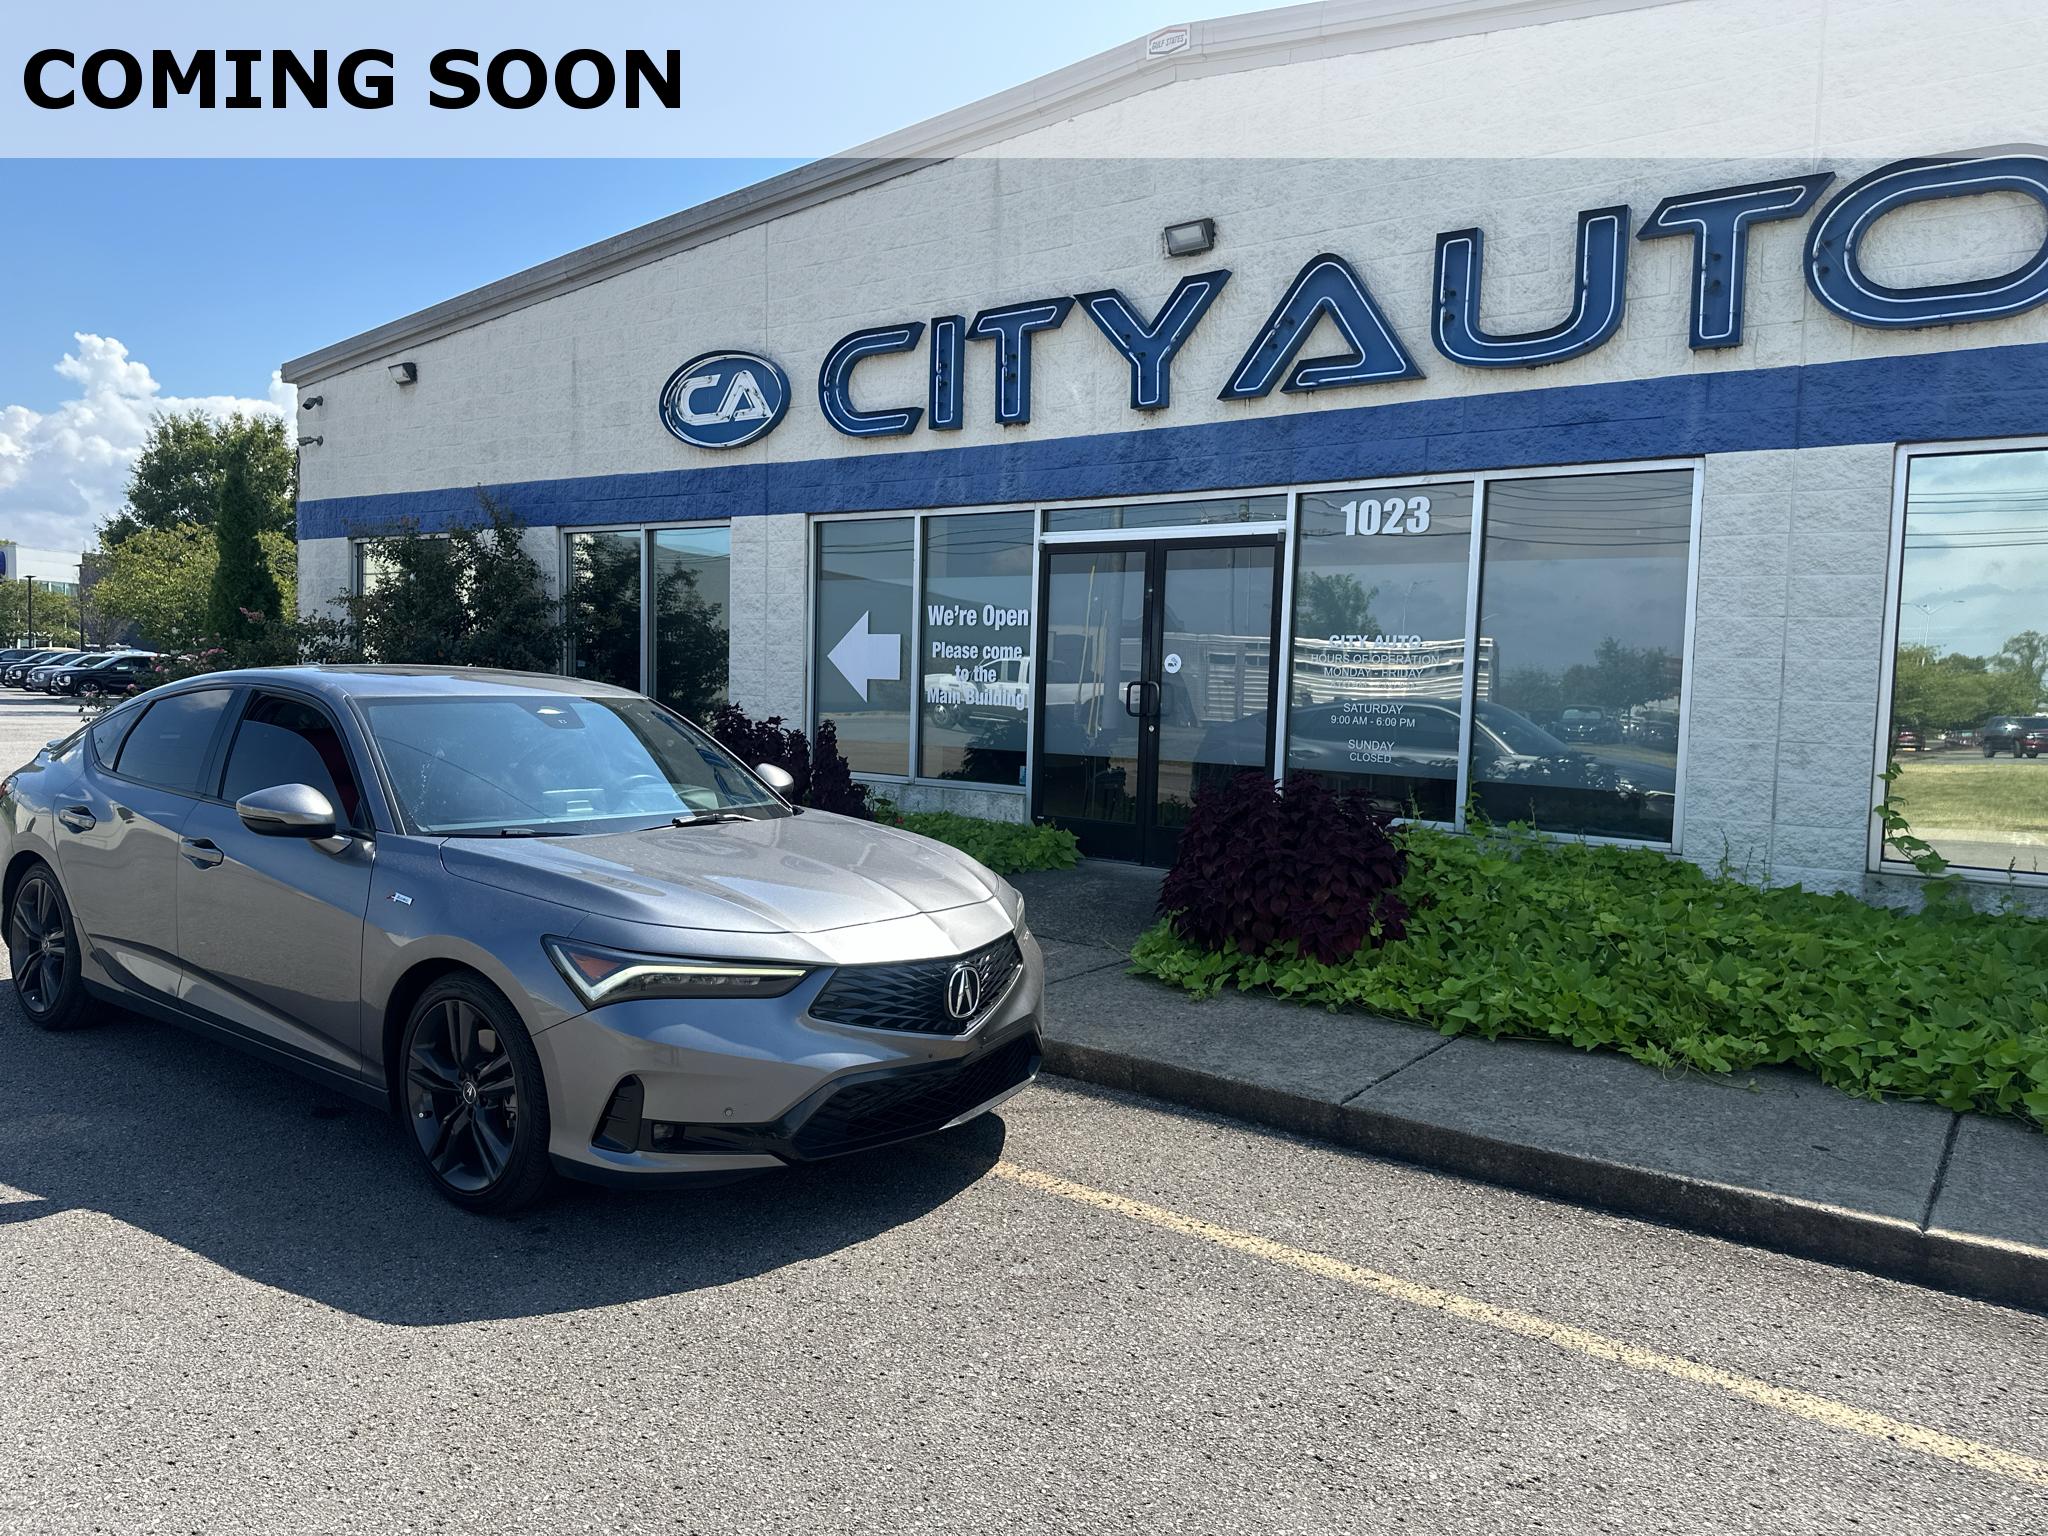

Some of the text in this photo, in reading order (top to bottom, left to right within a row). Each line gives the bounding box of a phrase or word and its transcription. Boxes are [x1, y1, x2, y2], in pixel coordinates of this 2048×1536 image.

[818, 143, 2048, 437] CITY AUTO
[675, 369, 773, 426] CA
[1340, 496, 1431, 536] 1023
[928, 604, 1029, 631] We're Open
[1329, 635, 1422, 648] CITY AUTO
[932, 641, 1023, 659] Please come
[1311, 653, 1440, 665] HOURS OF OPERATION
[955, 665, 997, 683] to the
[1323, 667, 1371, 678] MONDAY
[1381, 668, 1424, 678] FRIDAY
[927, 688, 1025, 711] Main Building
[1343, 703, 1404, 715] SATURDAY
[1330, 715, 1350, 725] 9:00
[1352, 716, 1367, 726] AM
[1376, 717, 1396, 727] 6:00
[1399, 718, 1415, 728] PM
[1348, 739, 1395, 751] SUNDAY
[1349, 753, 1392, 764] CLOSED
